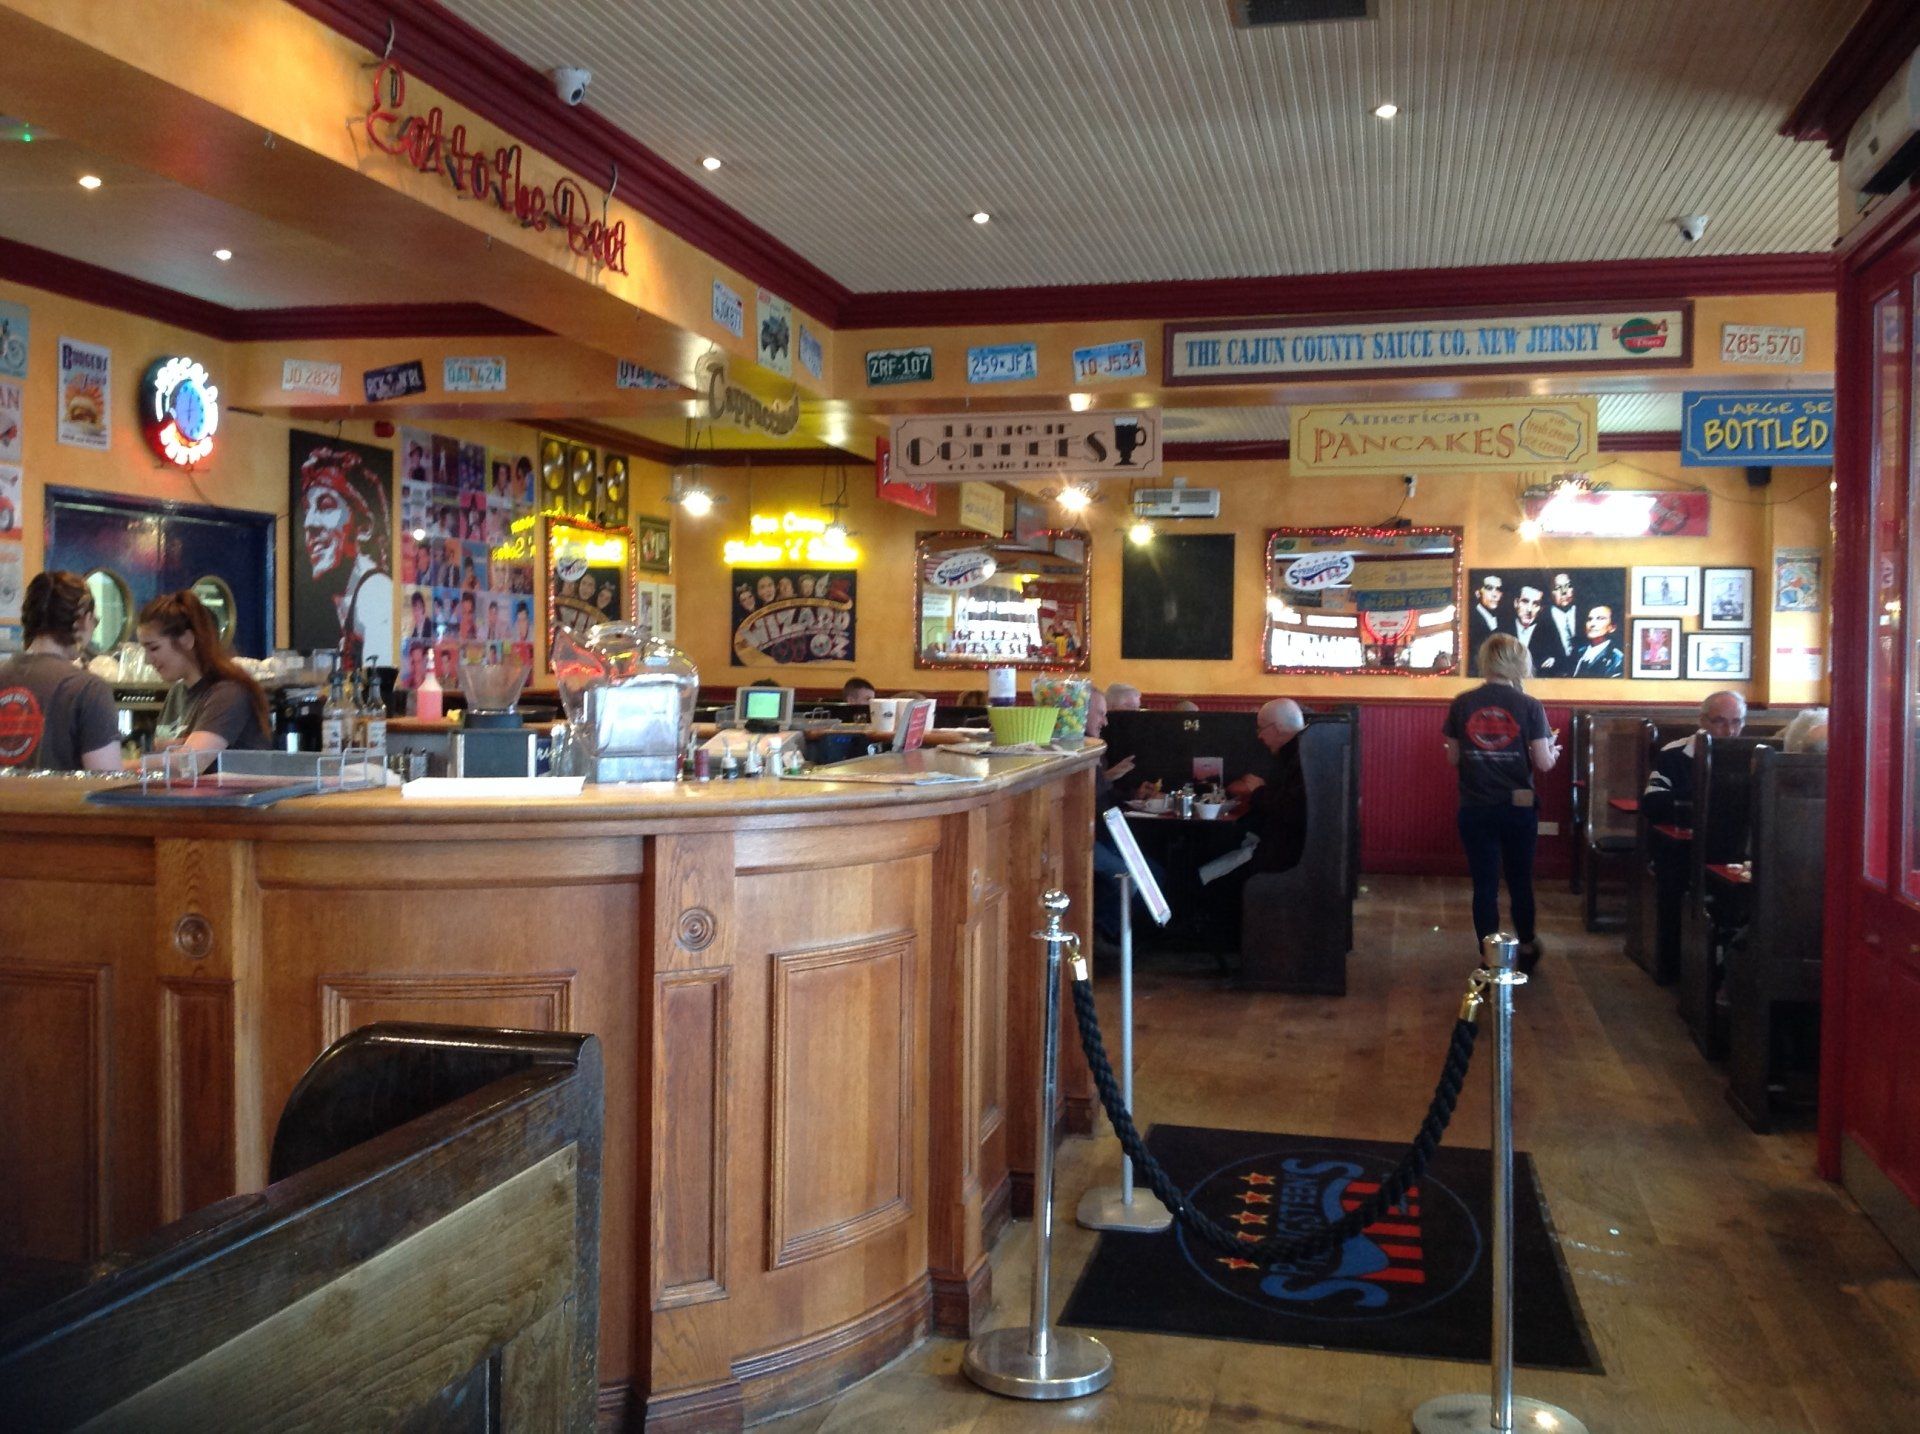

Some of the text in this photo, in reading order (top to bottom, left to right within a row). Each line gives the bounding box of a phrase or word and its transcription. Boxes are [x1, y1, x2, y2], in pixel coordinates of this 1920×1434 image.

[1185, 323, 1602, 368] THE CAJUN COUNTY SAUCE CO. NEW JERSEY
[1725, 333, 1801, 355] Z85-570
[1340, 408, 1481, 426] American
[1718, 402, 1795, 415] LARGE
[906, 430, 1108, 467] COFFEES
[1313, 423, 1516, 464] PANCAKES
[1703, 416, 1829, 451] BOTTLED
[742, 606, 851, 650] WIZARD
